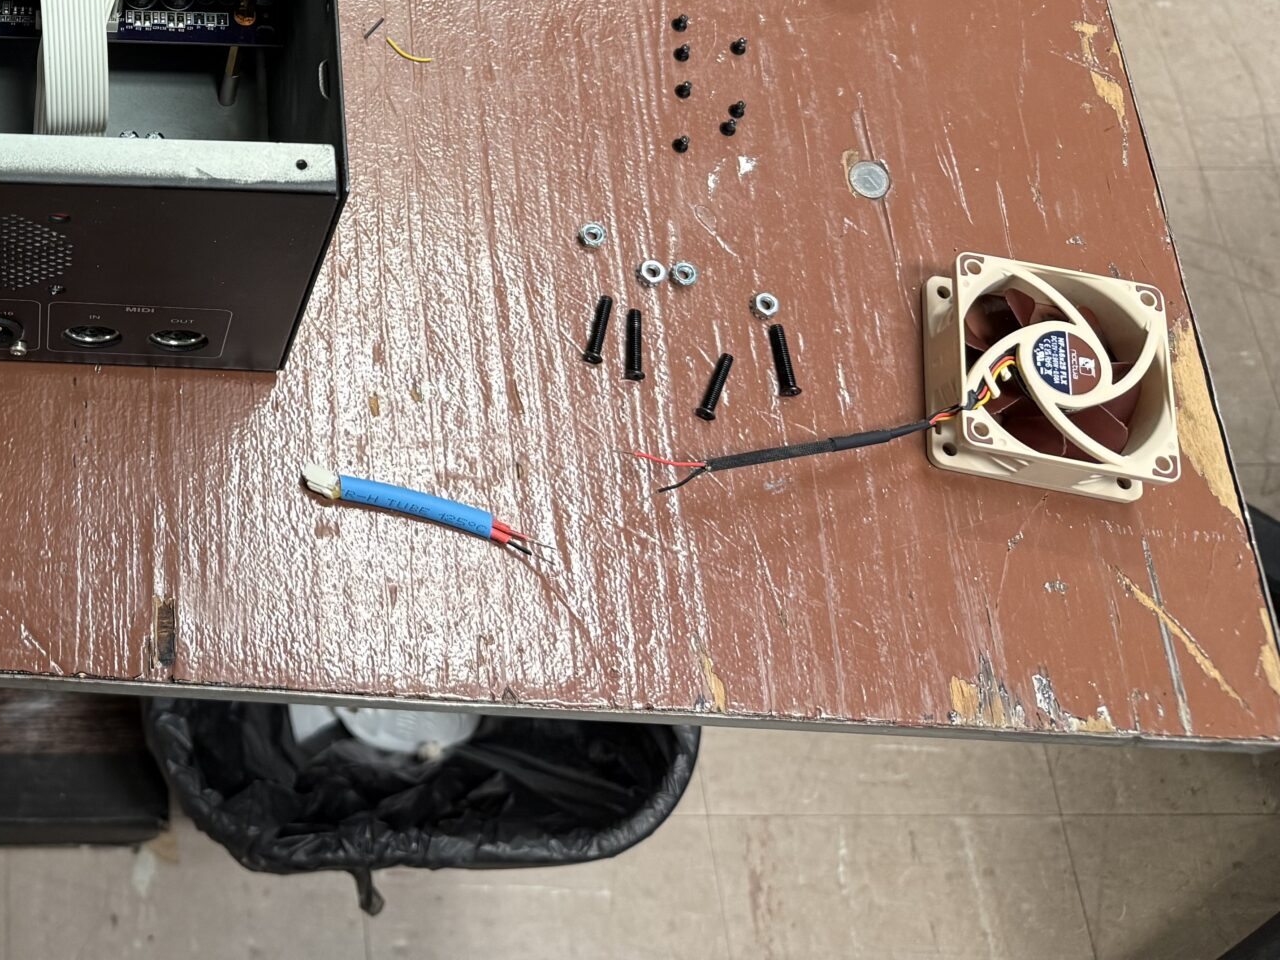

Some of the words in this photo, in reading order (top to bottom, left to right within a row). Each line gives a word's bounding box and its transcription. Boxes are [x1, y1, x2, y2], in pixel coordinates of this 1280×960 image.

[125, 306, 156, 314] MIDI
[1070, 348, 1079, 380] noctua
[387, 498, 431, 516] TUBE
